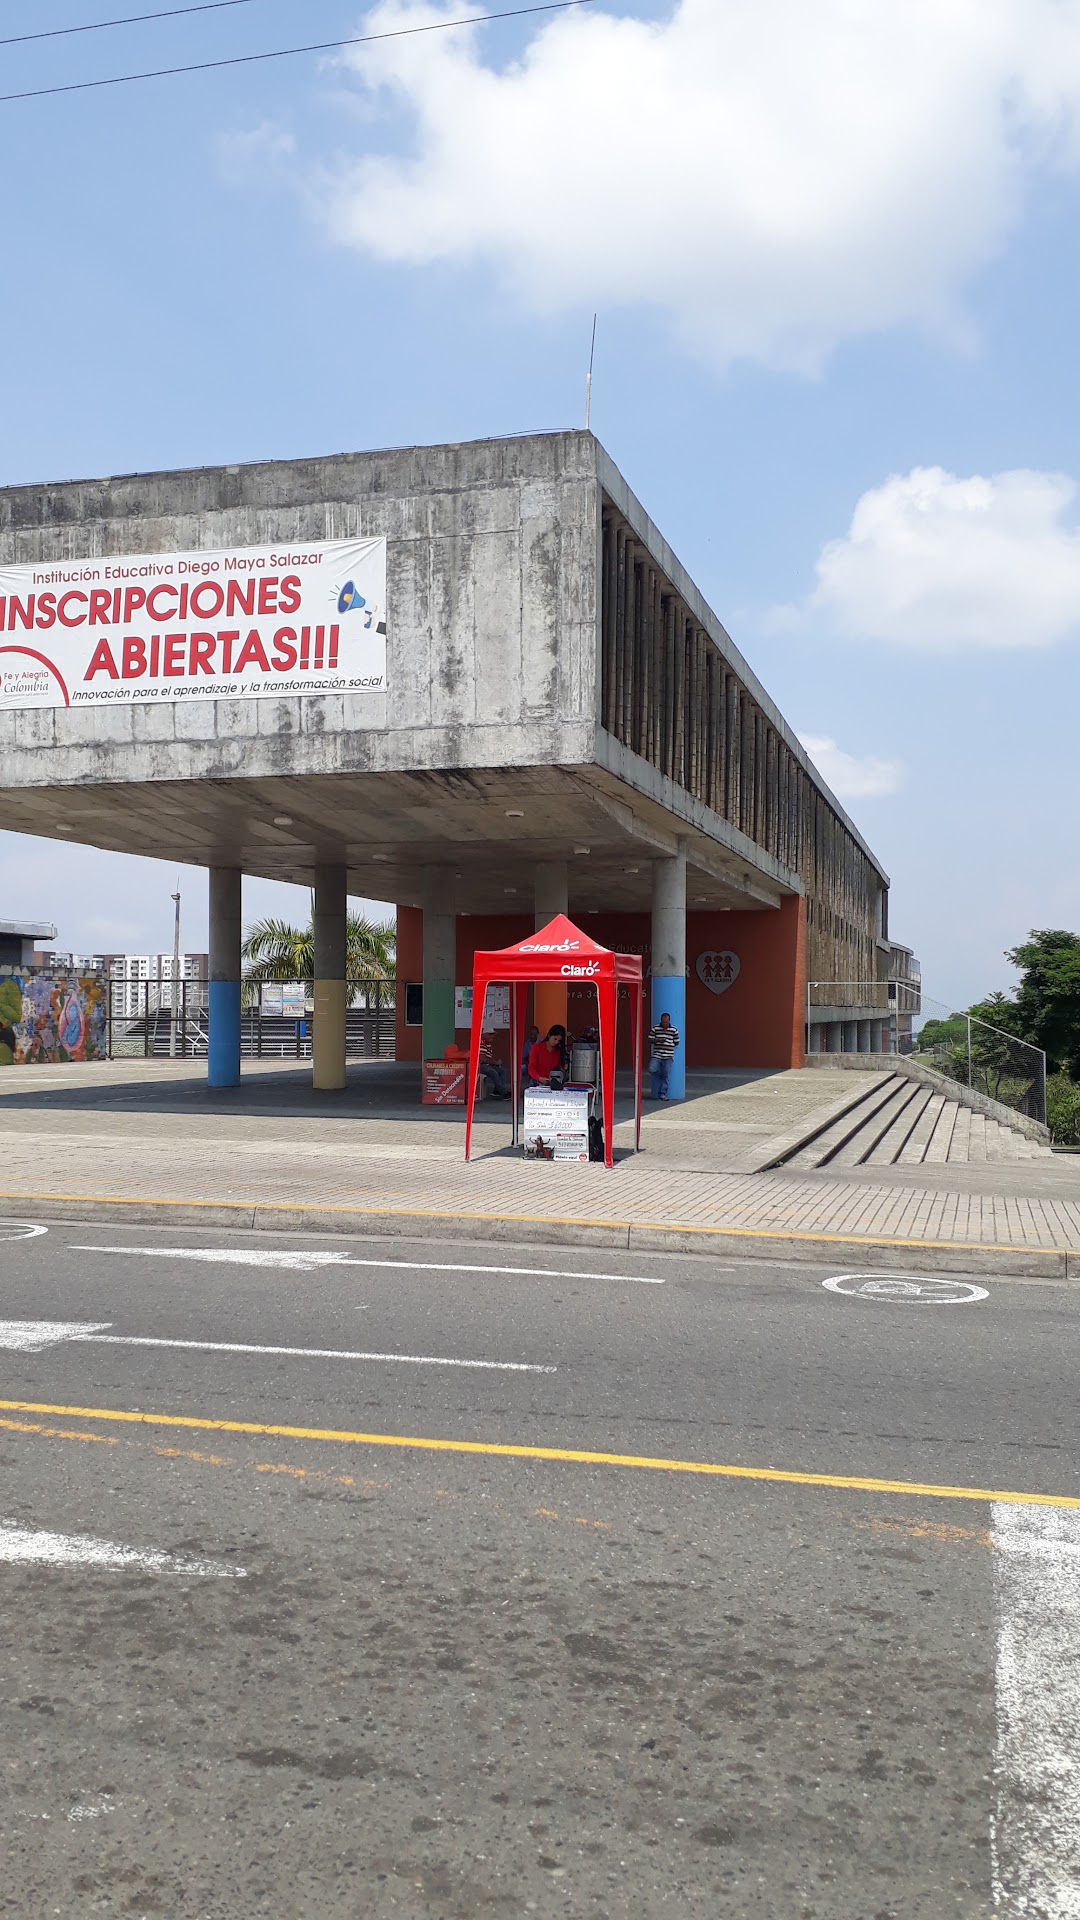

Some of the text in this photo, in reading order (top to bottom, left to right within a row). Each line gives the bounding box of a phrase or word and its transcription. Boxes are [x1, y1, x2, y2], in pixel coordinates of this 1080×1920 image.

[33, 553, 323, 584] Institución Educativa Diego Maya Salazar
[0, 575, 302, 631] INSCRIPCIONES
[83, 624, 339, 681] ABIERTAS!!!
[4, 672, 13, 680] Fe
[14, 673, 20, 681] y
[4, 680, 49, 693] Colombia
[72, 675, 383, 700] Innovación para el aprendizaje y la transformación social
[561, 962, 598, 976] Claro
